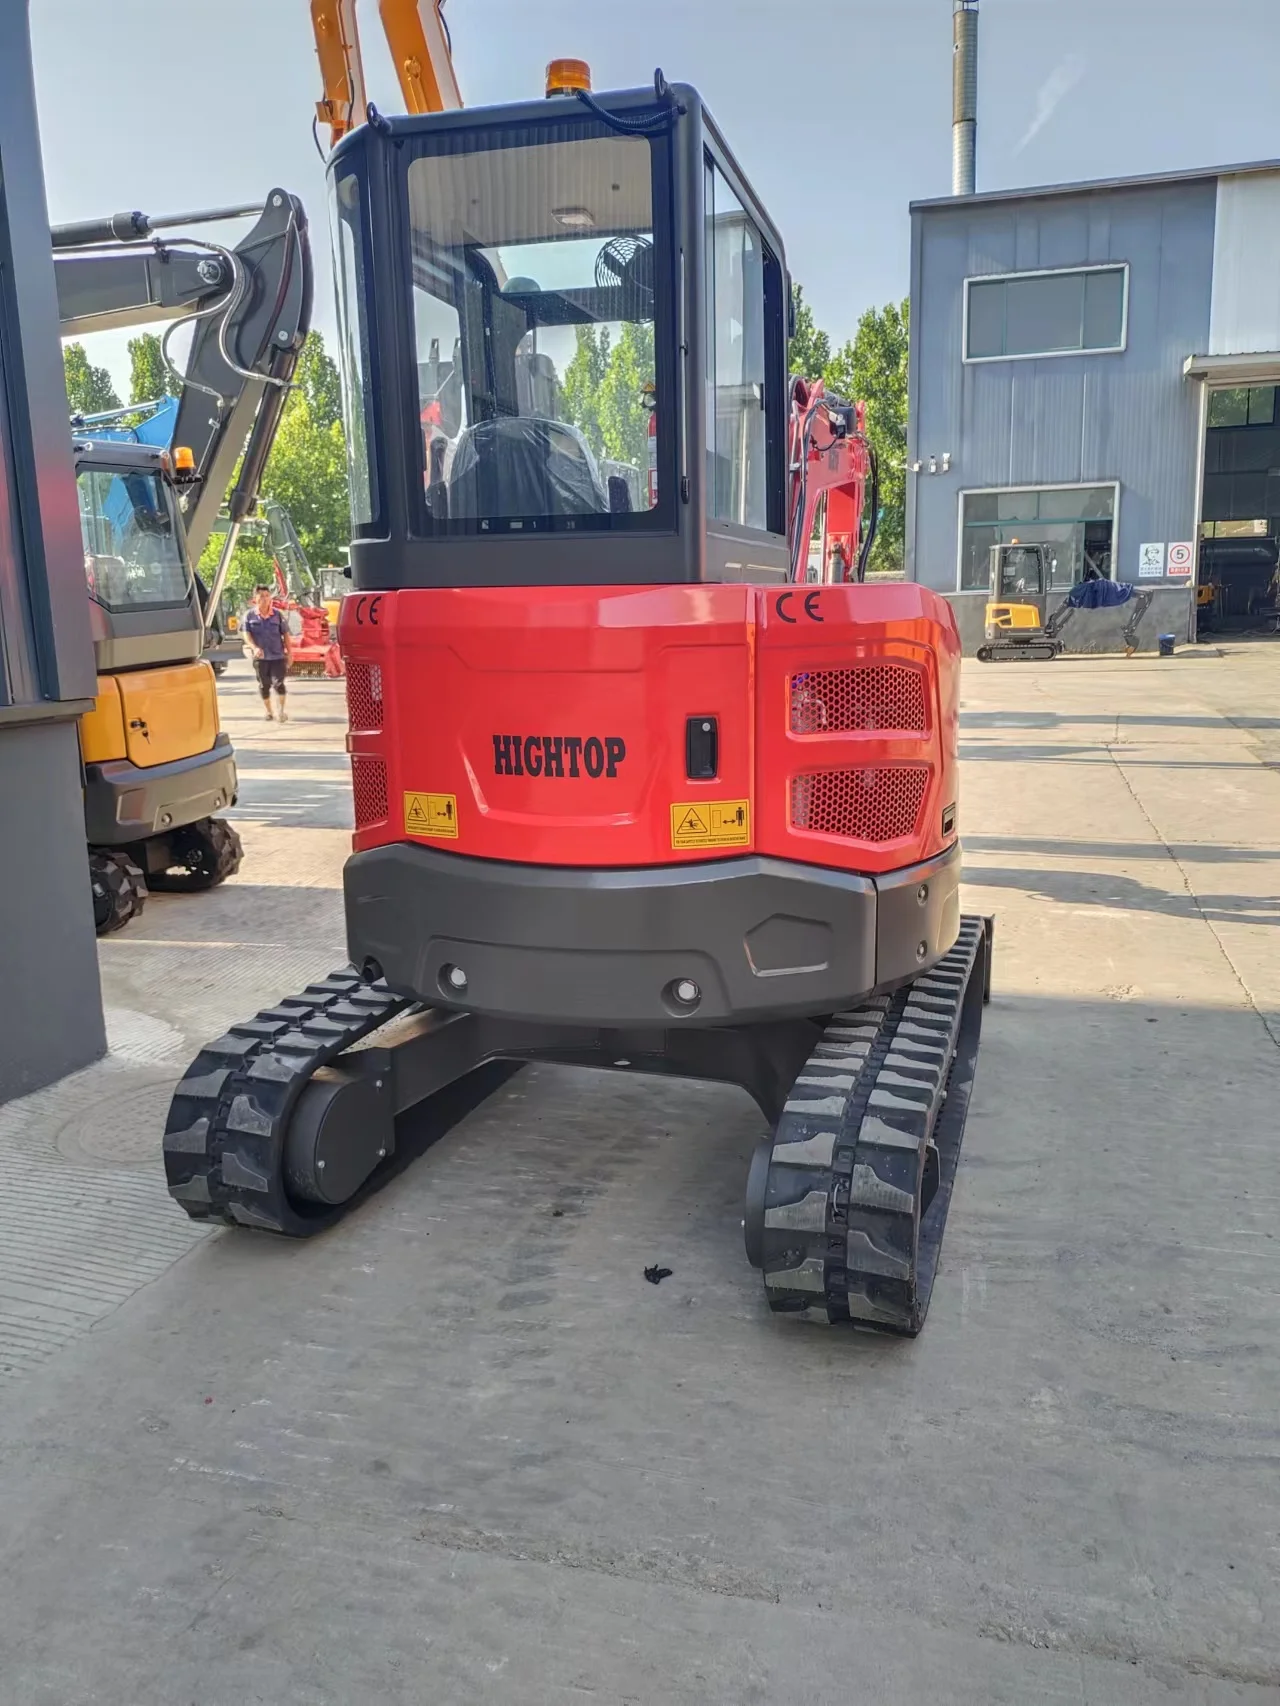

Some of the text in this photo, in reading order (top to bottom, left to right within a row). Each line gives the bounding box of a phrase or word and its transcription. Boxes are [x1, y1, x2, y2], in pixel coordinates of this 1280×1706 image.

[1176, 549, 1184, 560] 5
[356, 596, 381, 625] CE
[776, 591, 824, 623] CE
[492, 735, 626, 778] HIGHTOP
